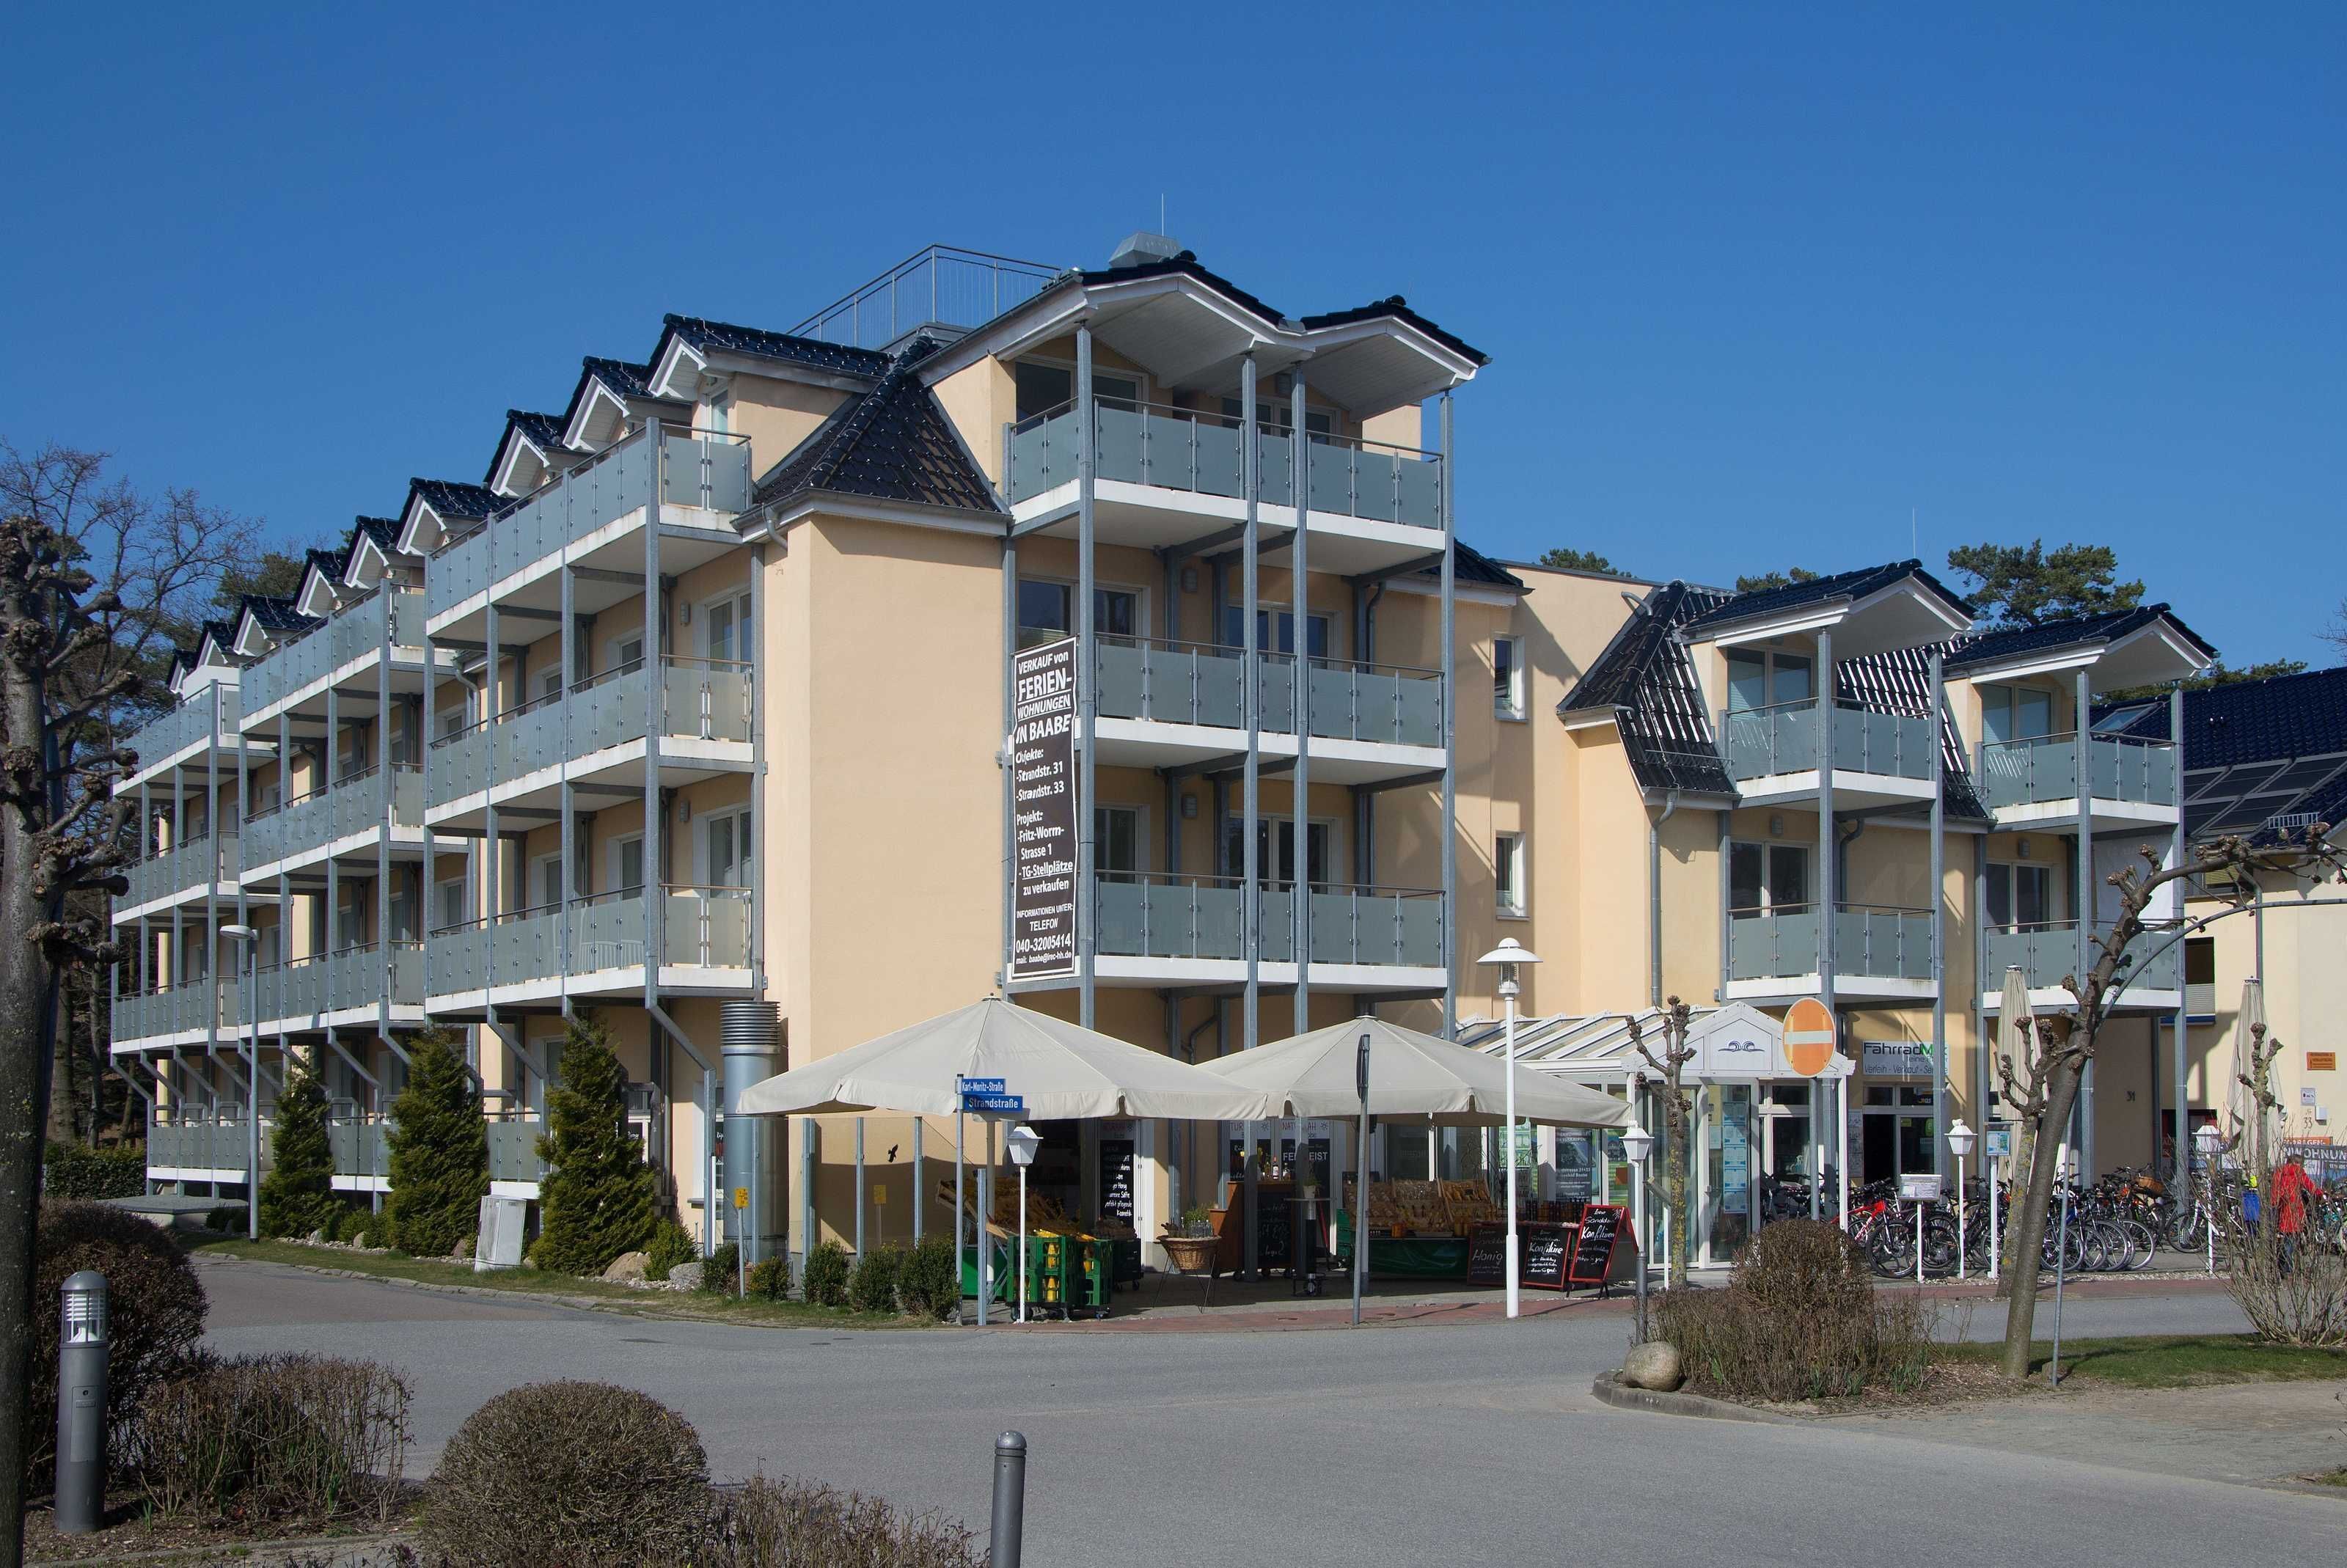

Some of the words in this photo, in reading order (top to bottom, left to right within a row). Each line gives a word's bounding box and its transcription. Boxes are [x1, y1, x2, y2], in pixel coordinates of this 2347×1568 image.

[1018, 653, 1053, 675] VERKAUF
[1053, 651, 1069, 664] von
[1018, 667, 1072, 702] FERIEN-
[1017, 694, 1071, 720] WOHNUNGEN
[1016, 725, 1028, 744] IN
[1029, 714, 1072, 741] BAABE
[1016, 748, 1044, 765] Objekte:
[1016, 765, 1052, 783] -Strandstr.
[1053, 761, 1063, 774] 31
[1016, 784, 1053, 802] -Strandstr.
[1053, 780, 1064, 794] 33
[1017, 810, 1044, 827] Projekt:
[1017, 825, 1064, 843] -Fritz-Worm-
[1021, 846, 1046, 860] Strasse
[1047, 843, 1052, 856] 1
[1023, 885, 1031, 896] zu
[1032, 878, 1069, 894] verkaufen
[1017, 906, 1055, 918] INFORMATIONEN
[1030, 918, 1058, 931] TELEFON
[1016, 933, 1072, 953] 040-32005414
[1864, 1042, 1949, 1055] FahrradM
[962, 1081, 1003, 1092] Karl-Moritz-Straße
[969, 1098, 1019, 1108] Strandstraße
[2303, 1116, 2312, 1129] 33
[1283, 1151, 1328, 1161] FEEIST
[1472, 1249, 1503, 1266] Honig
